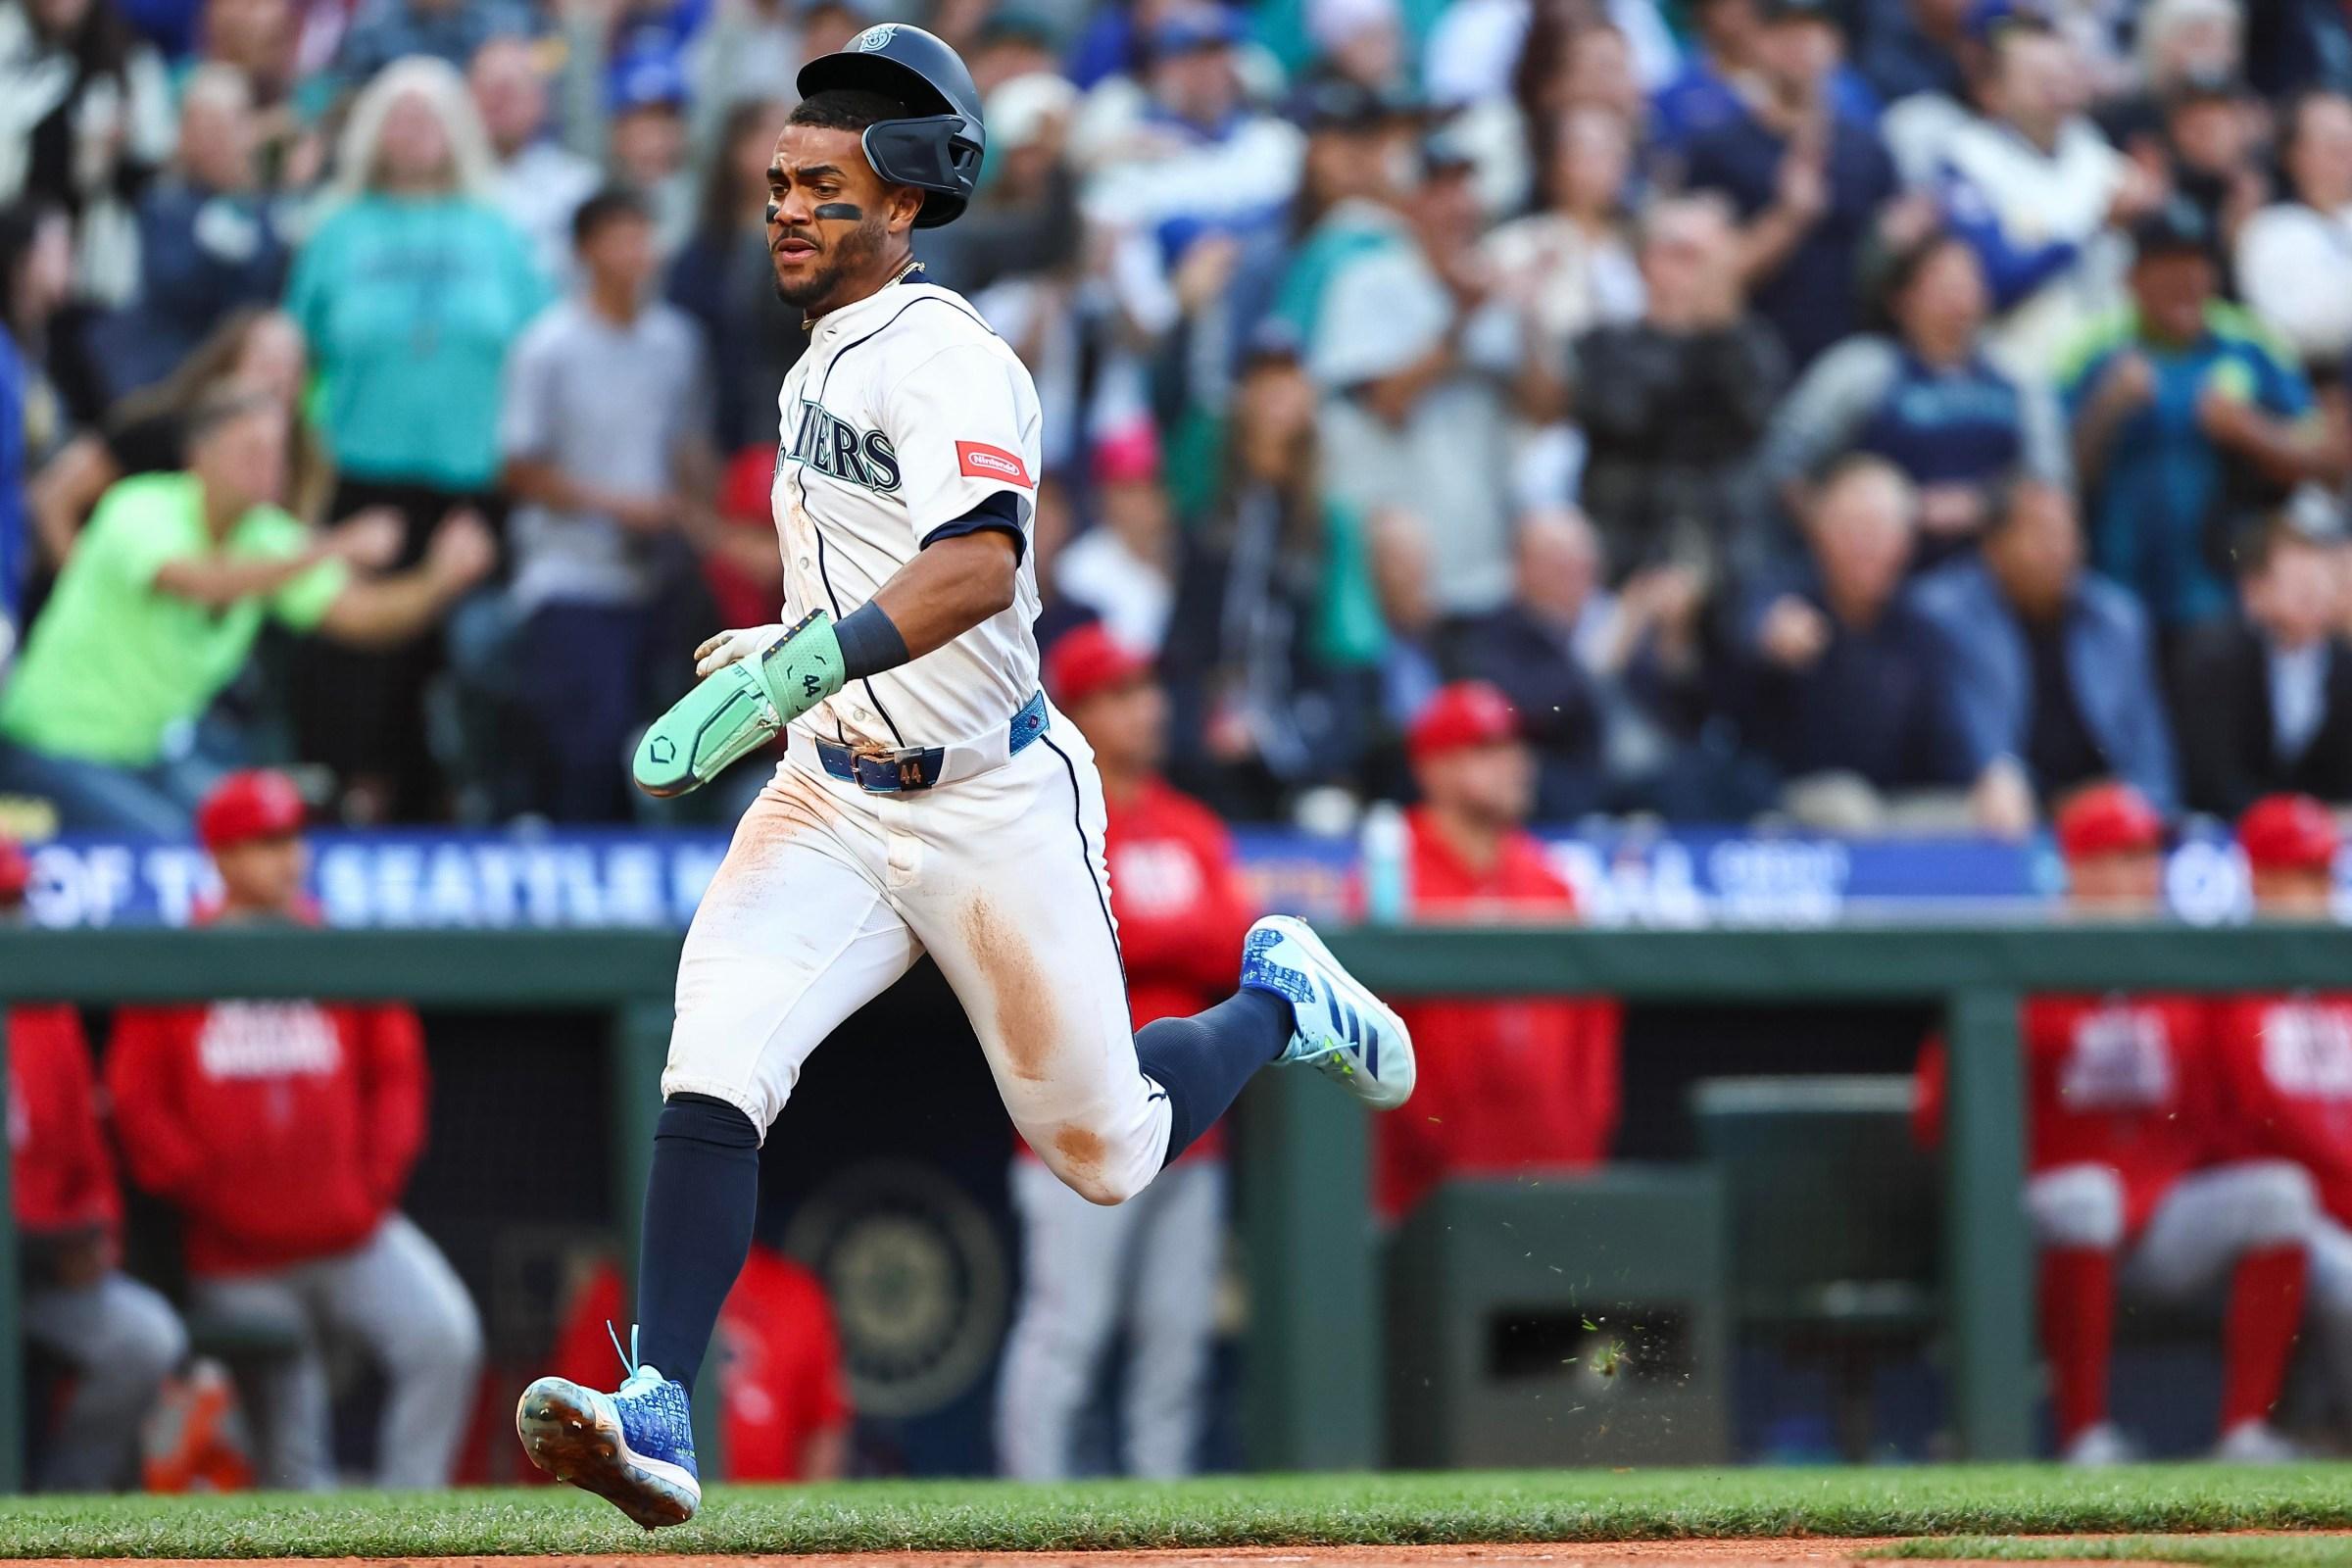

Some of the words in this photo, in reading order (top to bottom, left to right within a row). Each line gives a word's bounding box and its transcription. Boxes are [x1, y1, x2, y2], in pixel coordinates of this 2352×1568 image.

[971, 454, 1017, 473] Nintendo
[803, 674, 821, 698] 44
[900, 762, 922, 785] 44
[320, 843, 662, 927] SEATTLE
